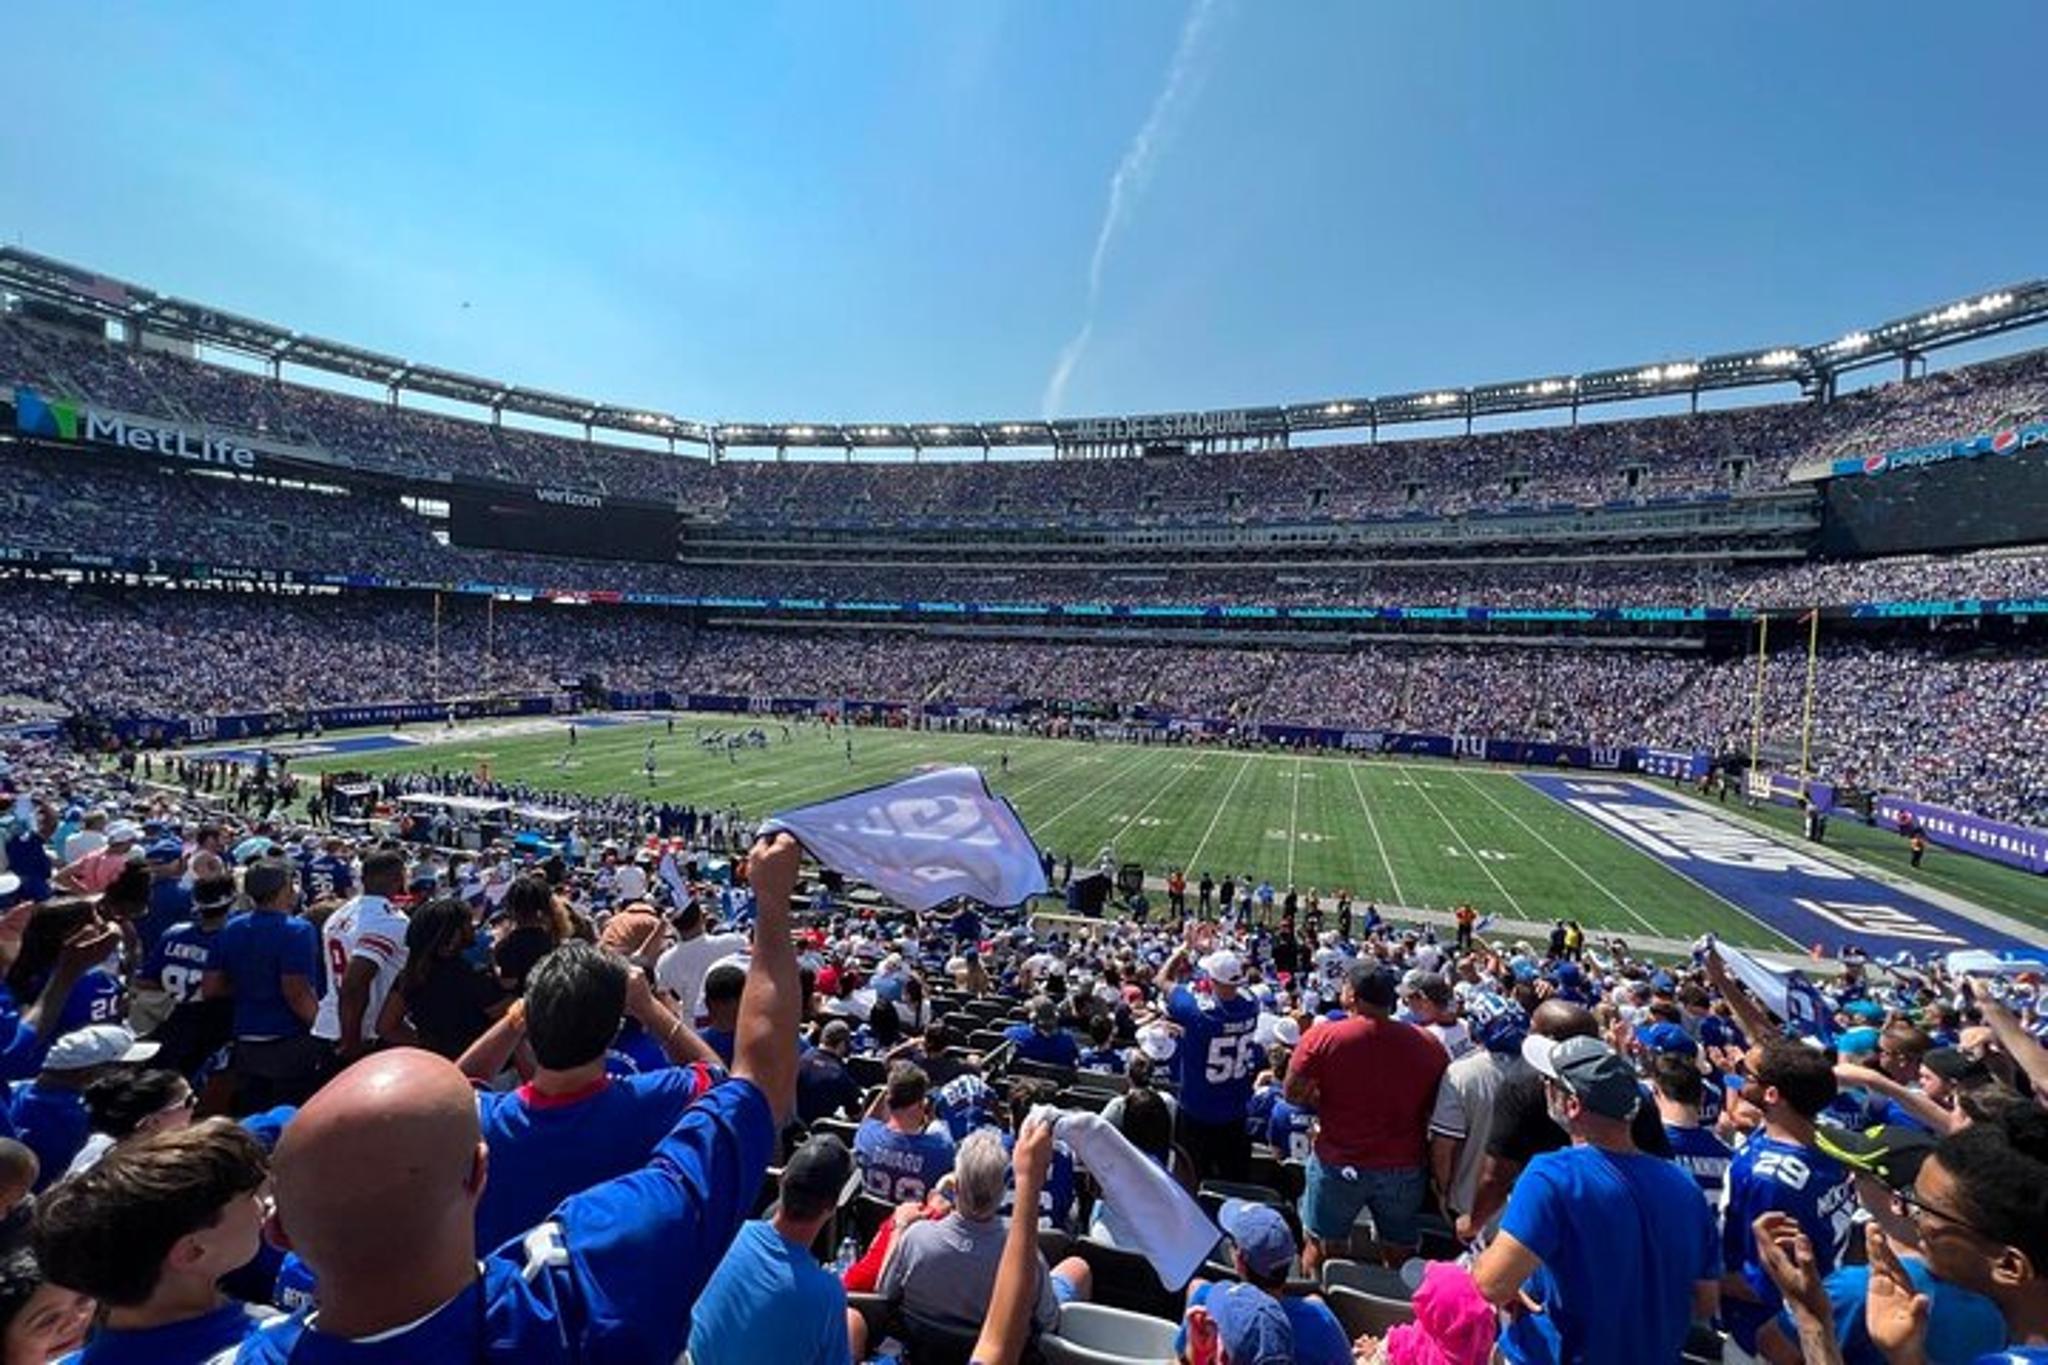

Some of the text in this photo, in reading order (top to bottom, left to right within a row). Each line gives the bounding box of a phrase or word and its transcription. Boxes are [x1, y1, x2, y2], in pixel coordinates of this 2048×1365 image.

[85, 410, 256, 467] MetLife
[1161, 411, 1247, 436] STADIUM
[535, 488, 602, 508] verizon
[1917, 815, 1955, 835] YORK
[1960, 827, 2038, 858] FOOTBALL
